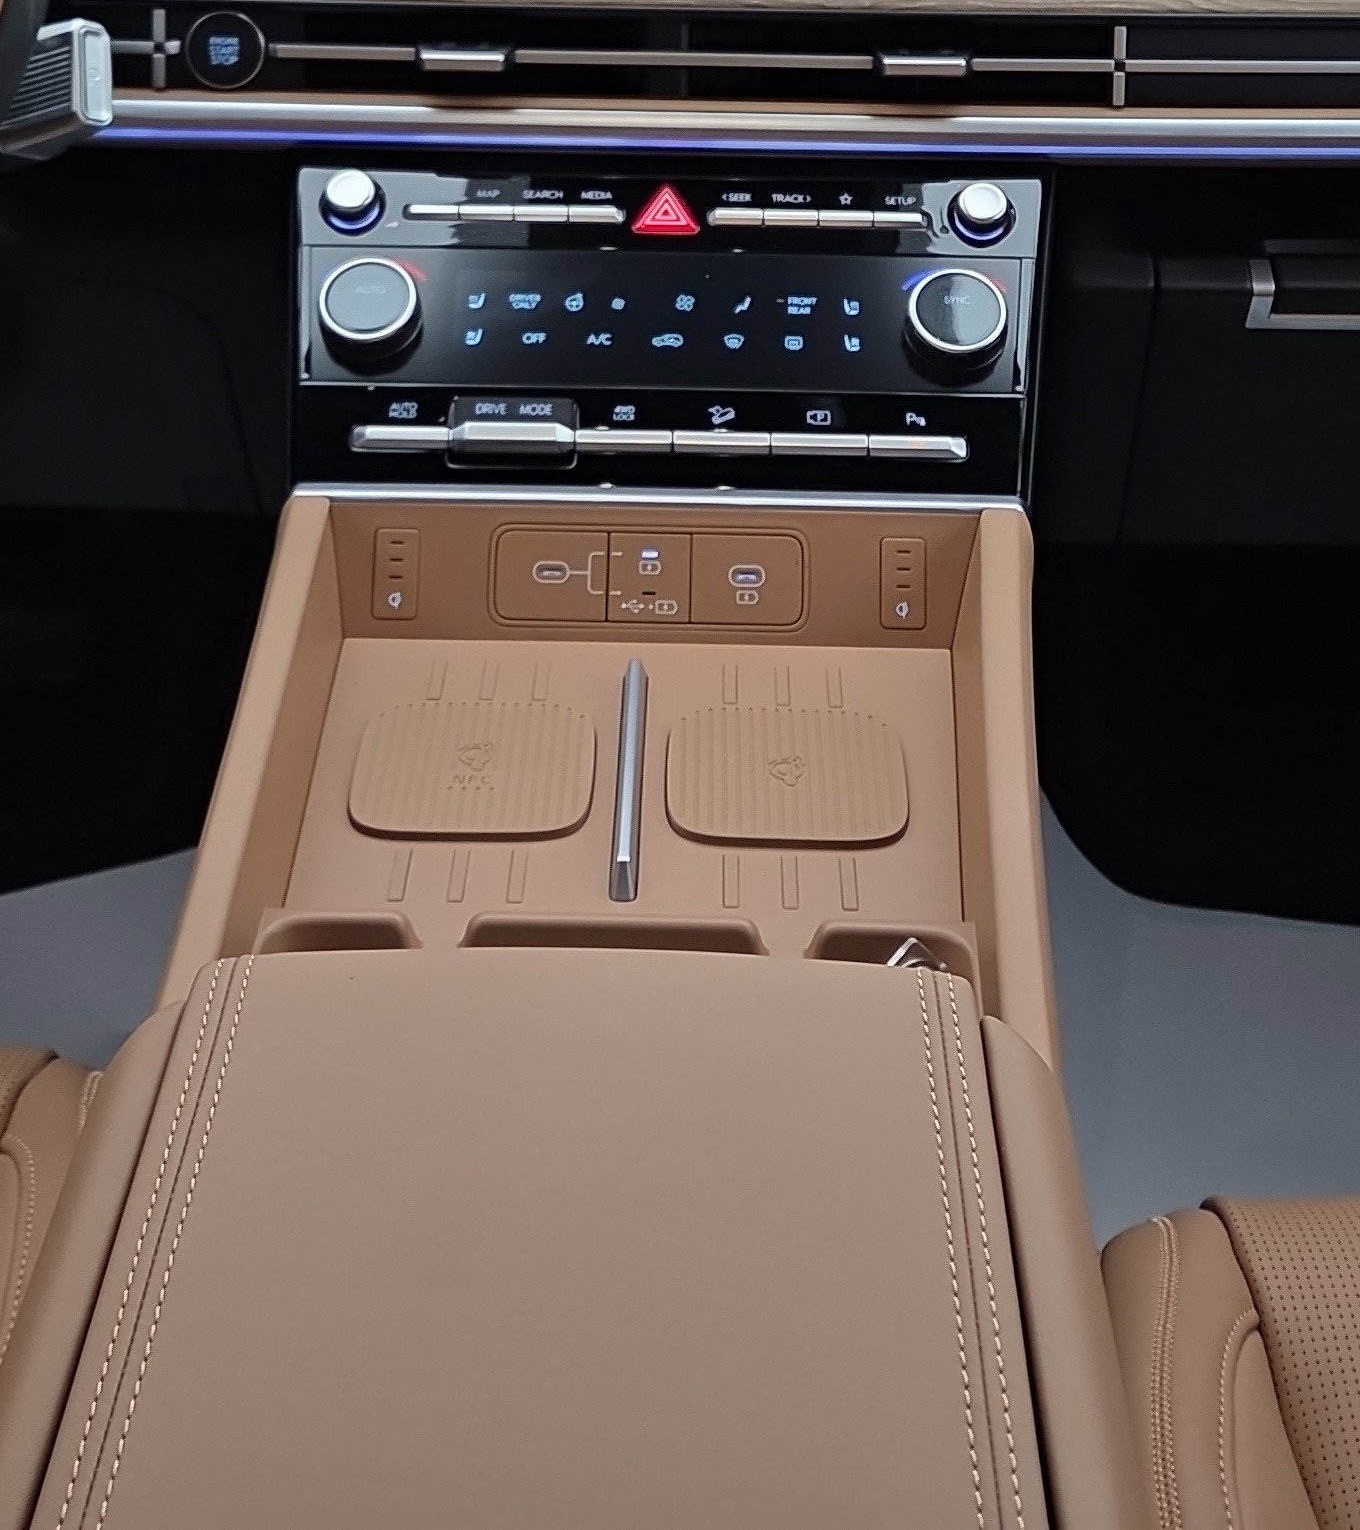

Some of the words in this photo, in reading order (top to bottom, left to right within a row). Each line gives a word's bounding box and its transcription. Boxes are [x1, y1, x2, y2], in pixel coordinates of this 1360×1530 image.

[476, 189, 501, 199] MAP
[522, 188, 564, 200] SEARCH
[580, 189, 613, 200] MEDIA
[728, 192, 753, 203] SEEK
[771, 193, 805, 204] TRACK
[884, 195, 917, 207] SETUP
[787, 296, 818, 306] FRONT
[943, 295, 971, 306] SYNC
[787, 306, 812, 315] REAR
[522, 332, 548, 345] OFF
[586, 333, 613, 346] A/C
[475, 403, 507, 415] DRIVE
[519, 404, 553, 416] MODE
